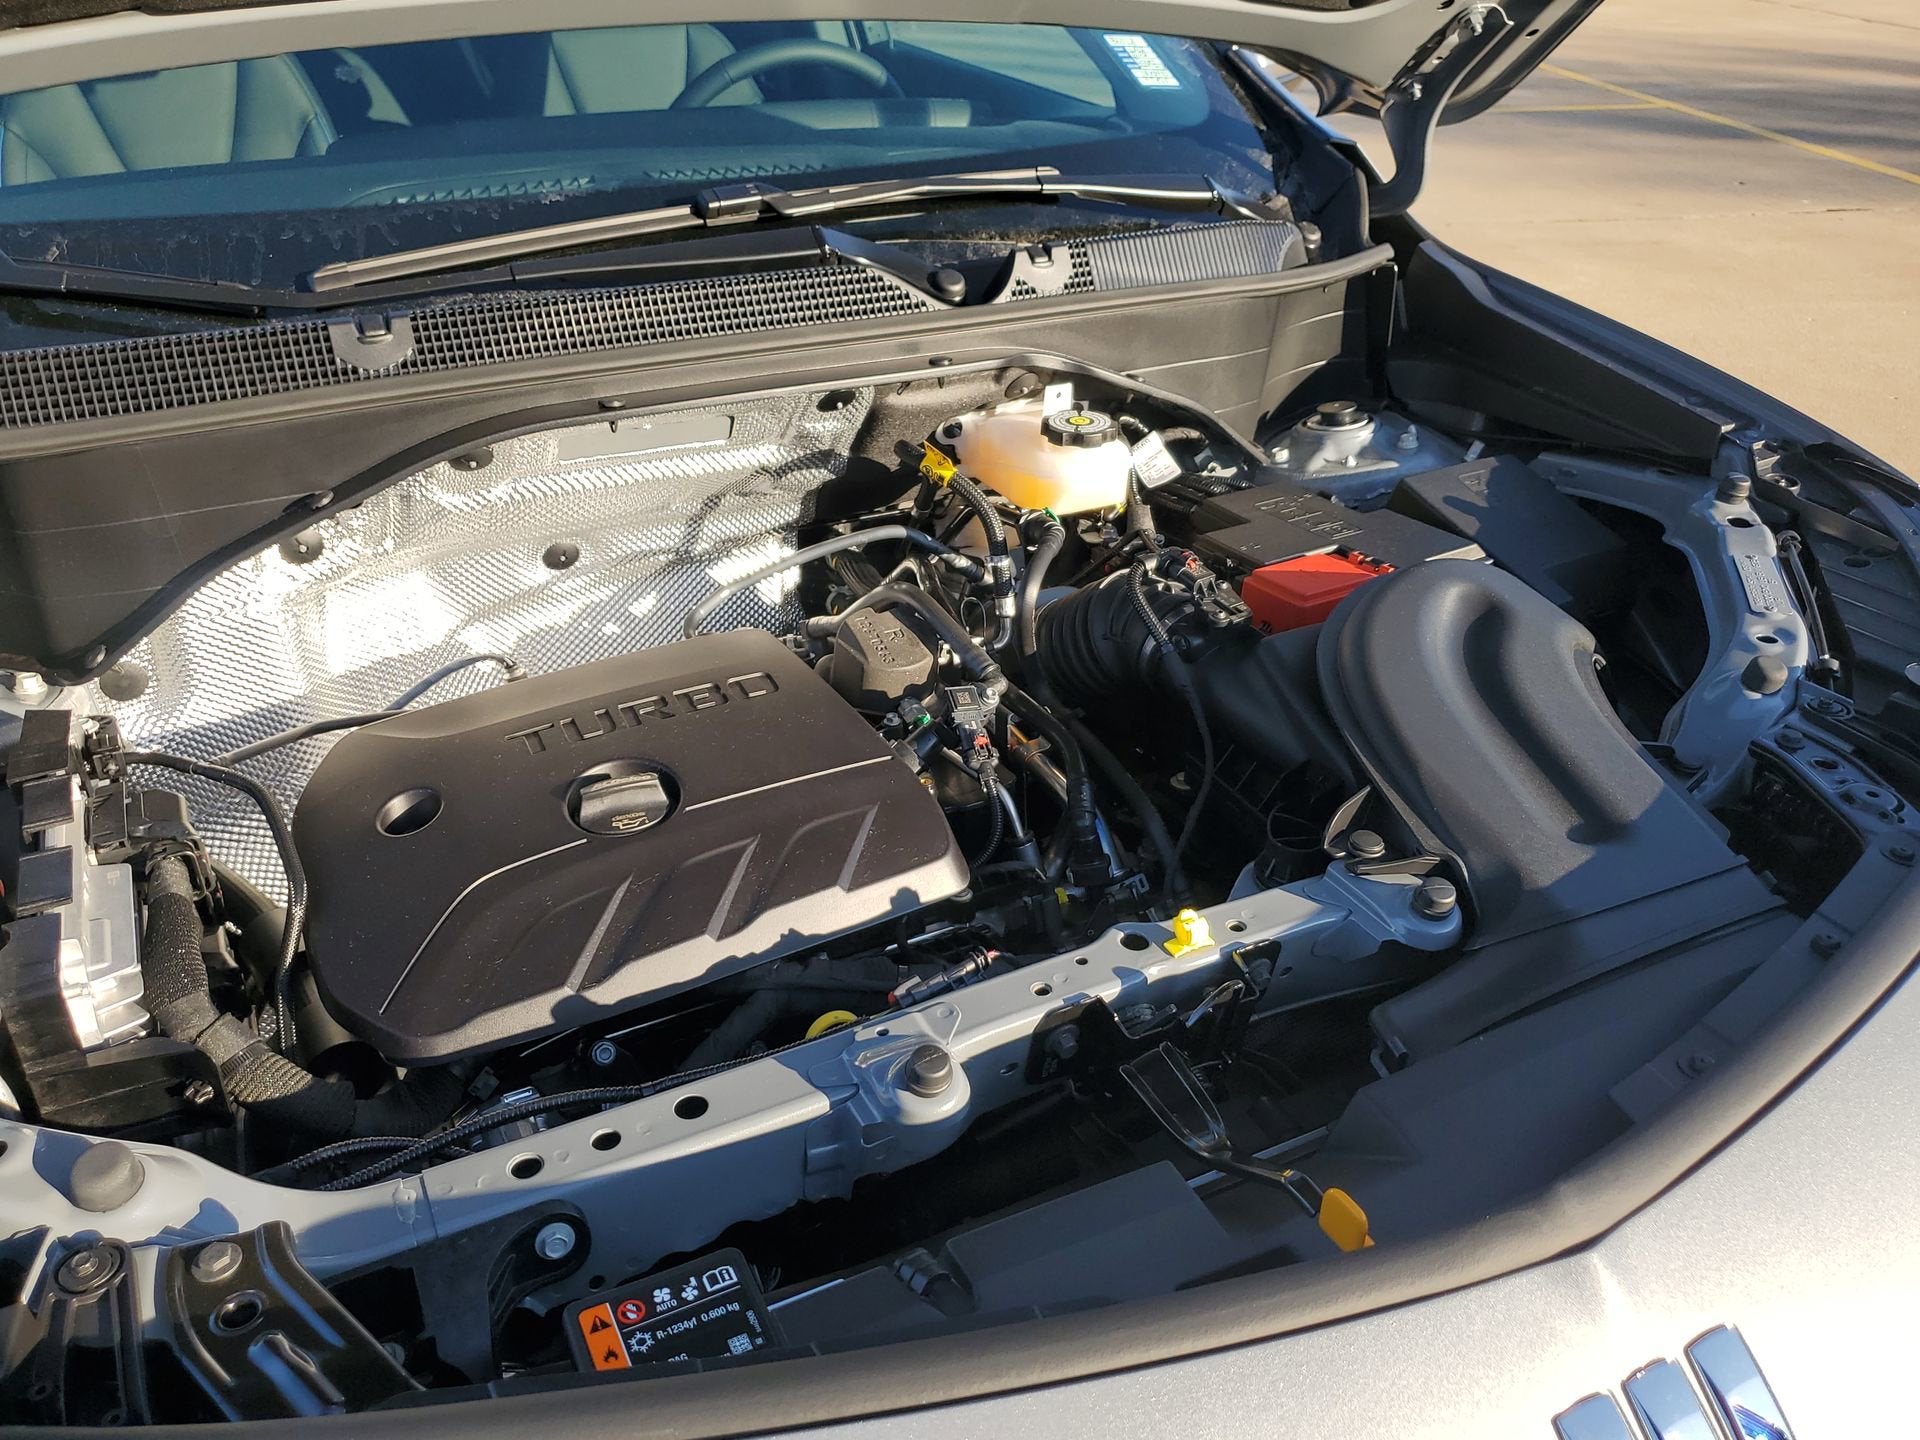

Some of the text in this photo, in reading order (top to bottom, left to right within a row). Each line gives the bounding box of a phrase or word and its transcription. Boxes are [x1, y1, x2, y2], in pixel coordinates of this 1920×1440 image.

[504, 671, 780, 755] TURBO
[656, 1300, 677, 1313] AUTO
[656, 1302, 740, 1339] R-1234yf 0.600 kg
